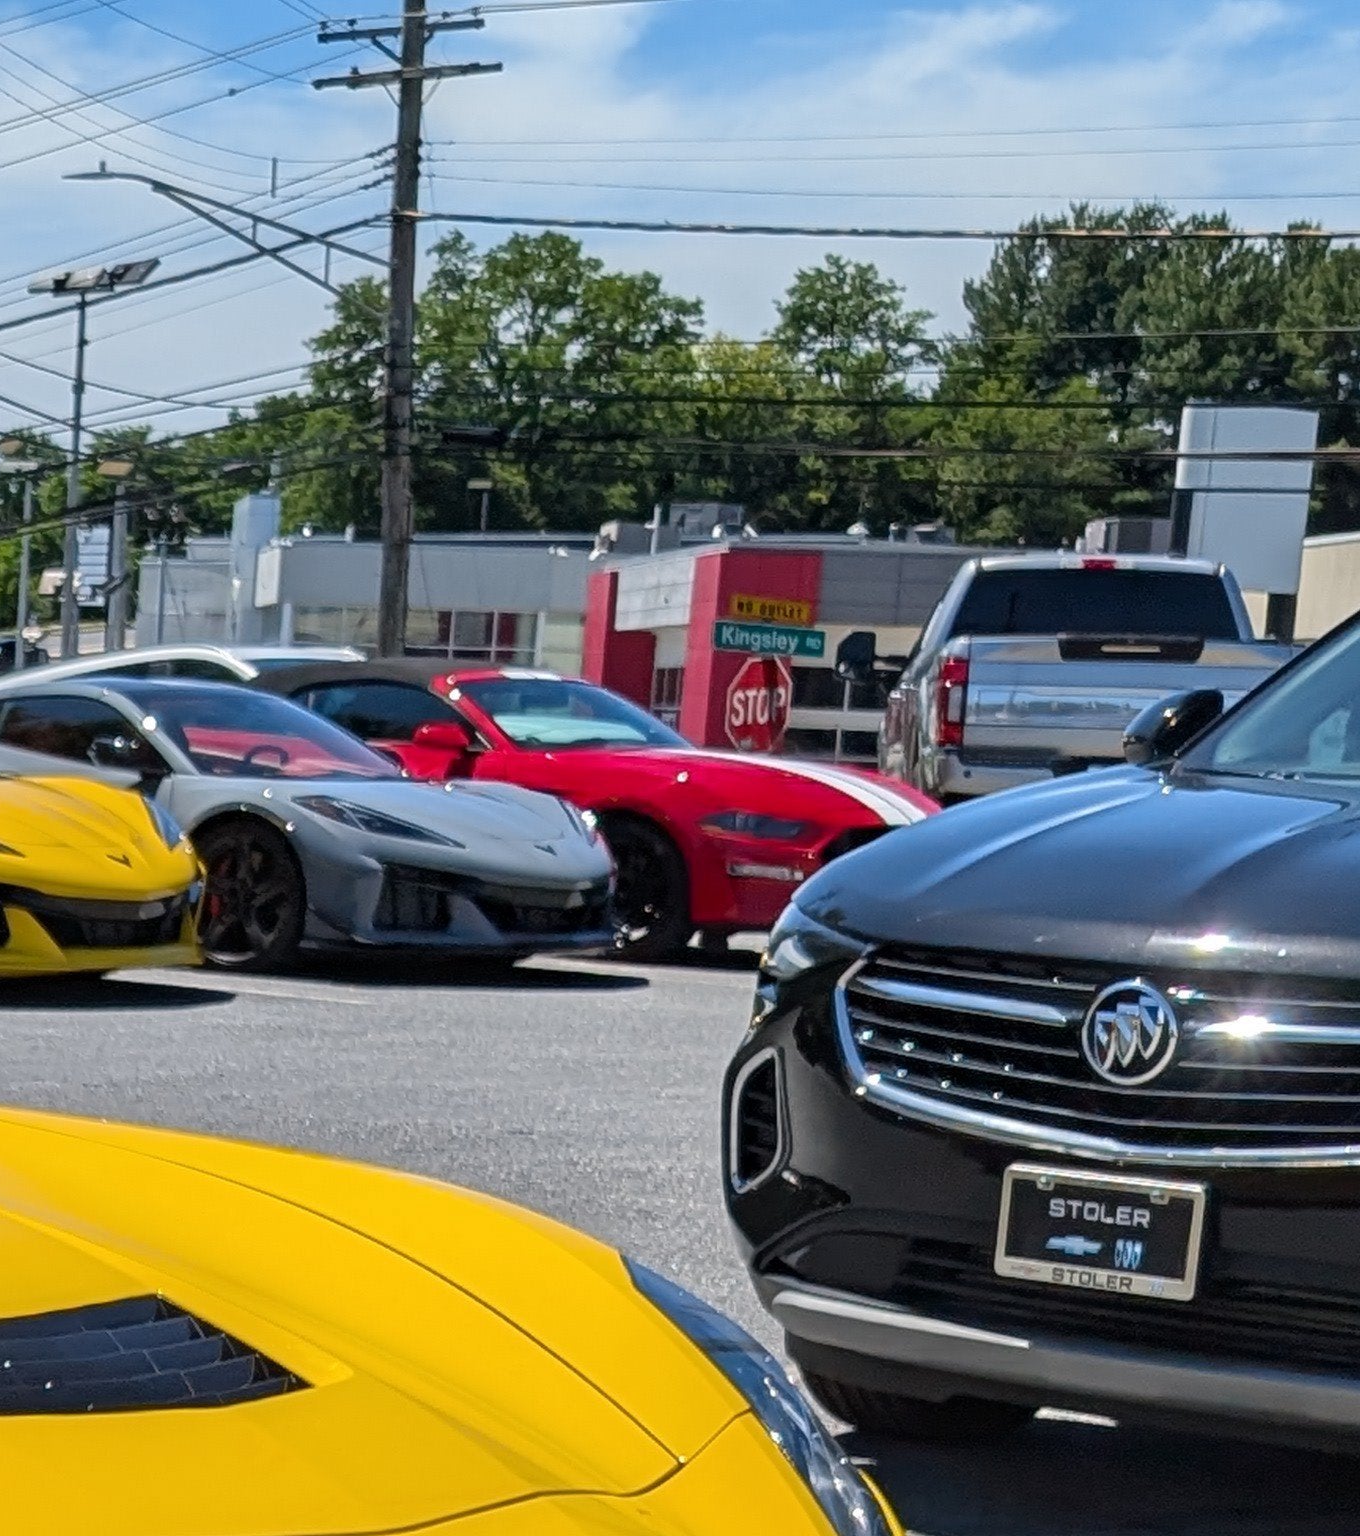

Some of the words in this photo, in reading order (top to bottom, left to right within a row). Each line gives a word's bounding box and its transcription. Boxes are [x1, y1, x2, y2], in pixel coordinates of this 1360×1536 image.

[722, 625, 798, 655] Kingsley
[731, 686, 786, 727] STOP
[1048, 1197, 1151, 1229] STOLER
[1051, 1266, 1133, 1292] STOLER
